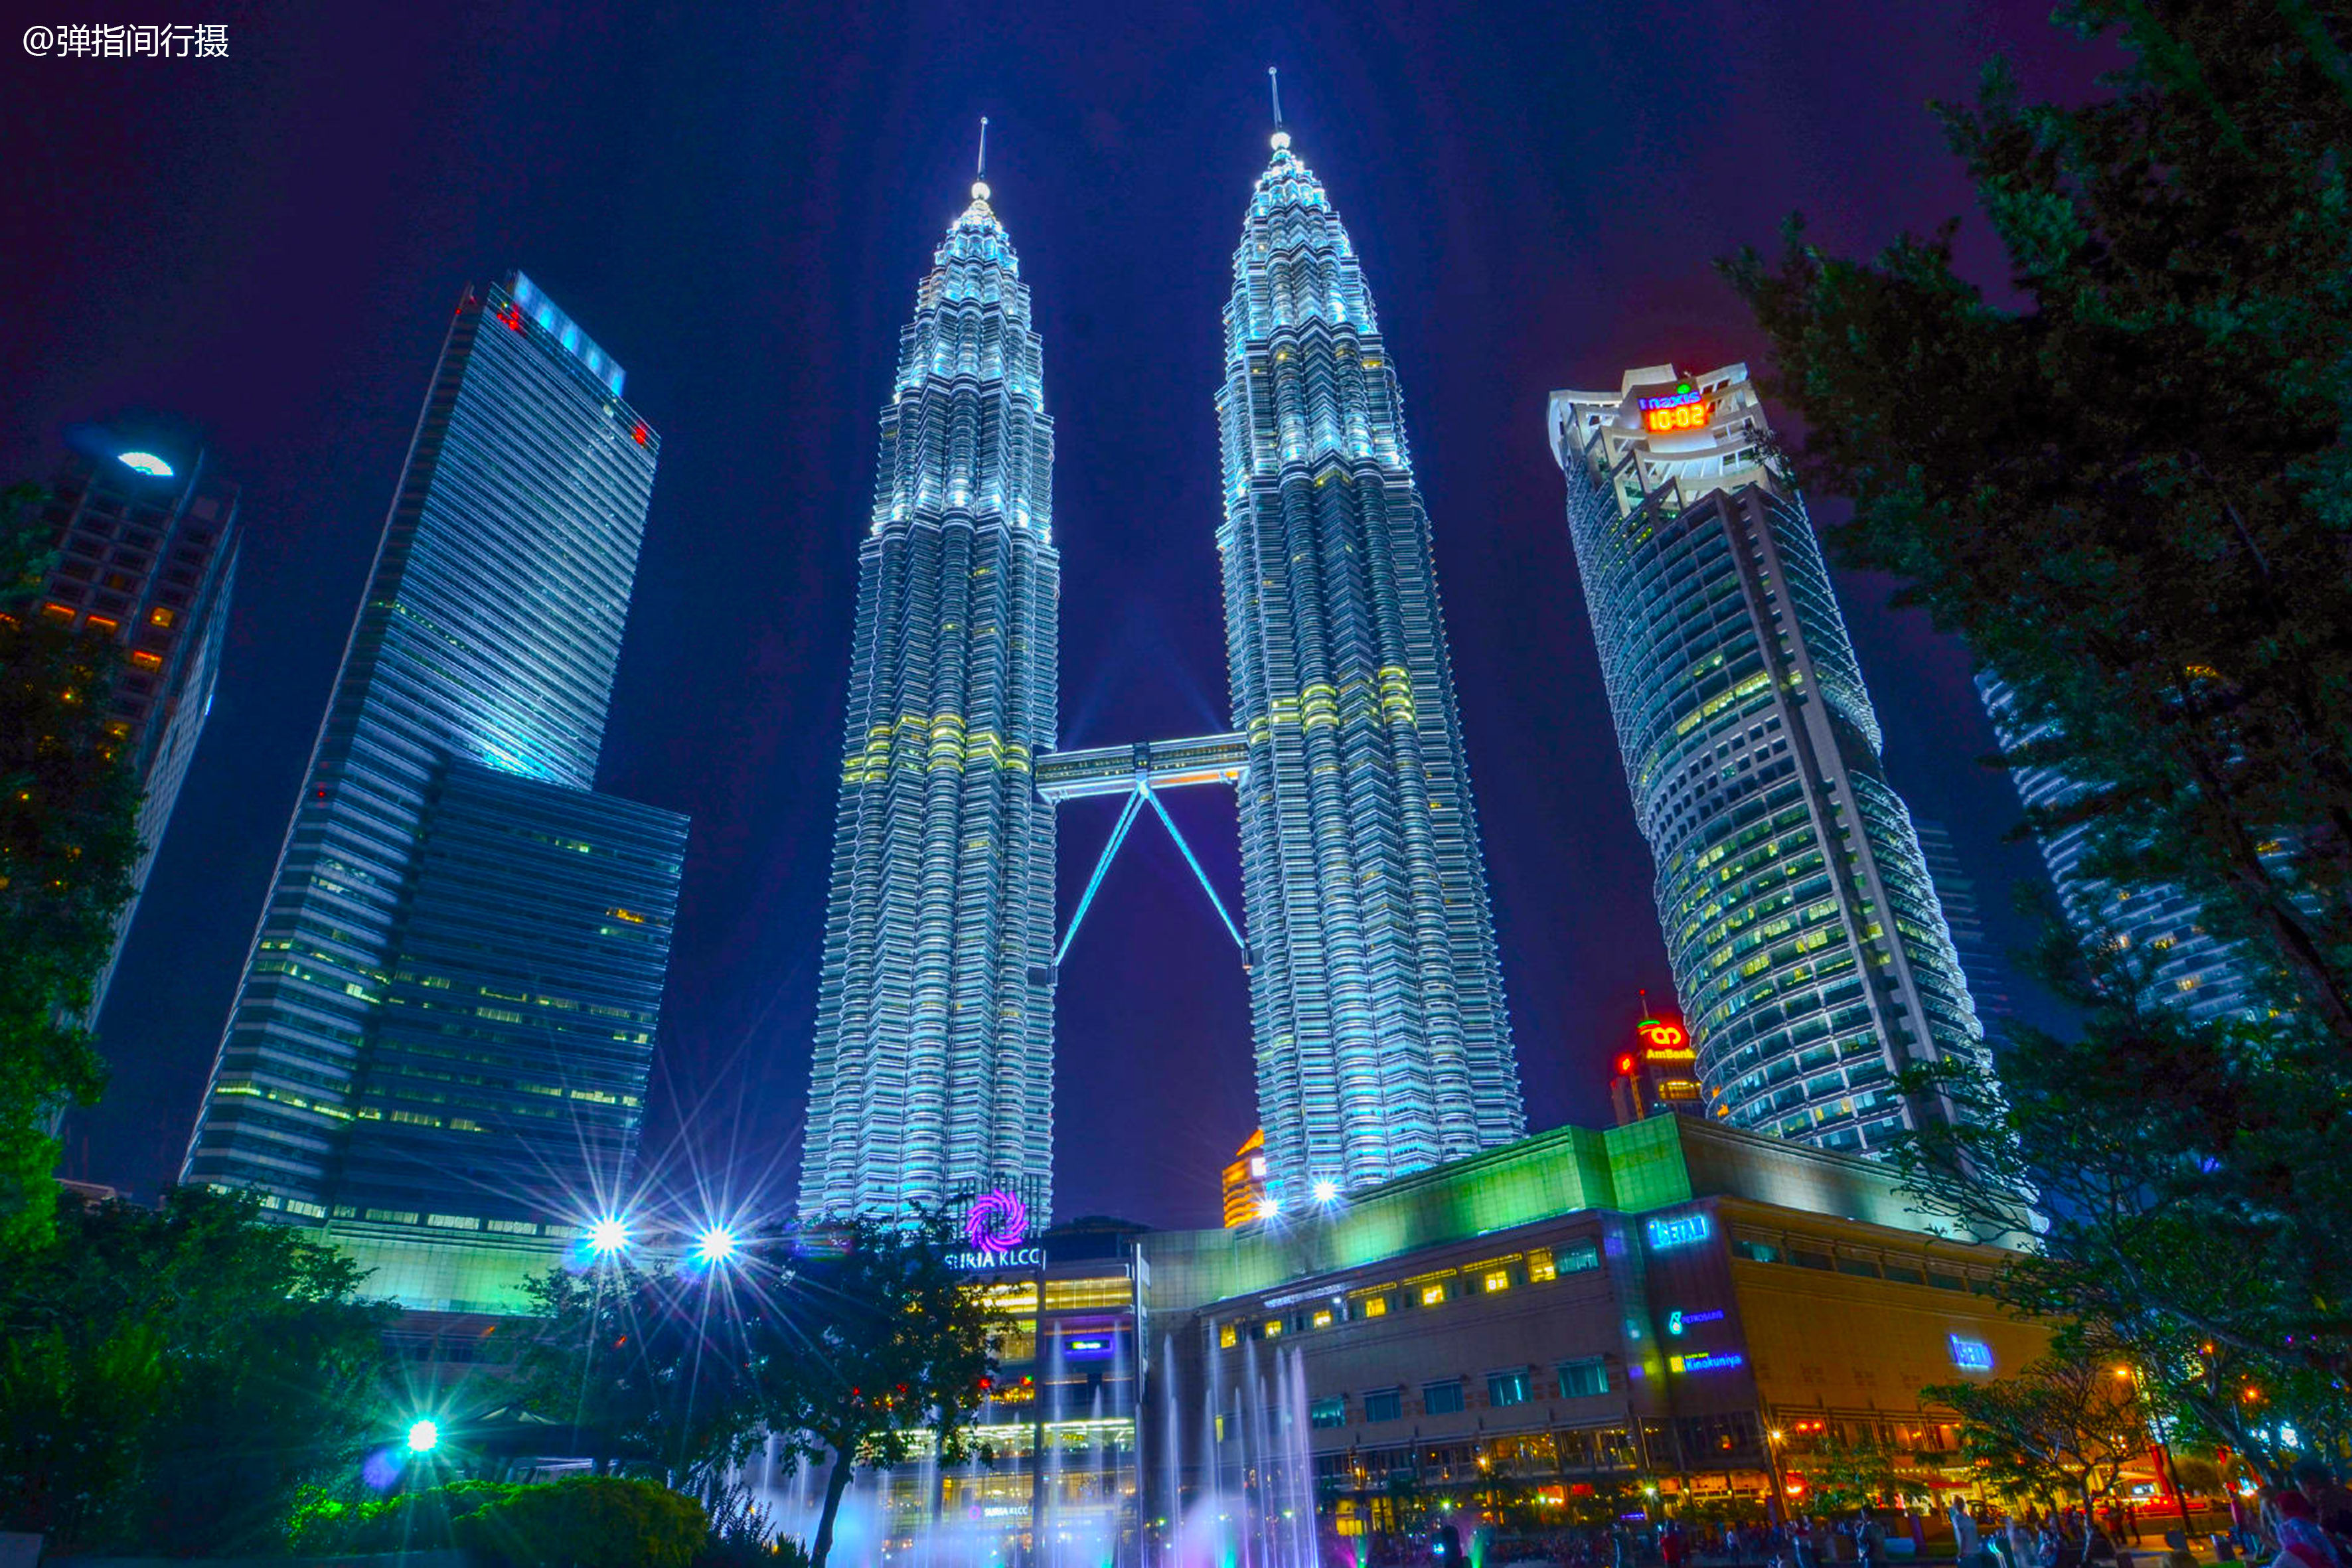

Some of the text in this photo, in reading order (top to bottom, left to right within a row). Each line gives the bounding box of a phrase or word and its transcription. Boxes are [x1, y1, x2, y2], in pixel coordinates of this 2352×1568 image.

[1649, 404, 1704, 430] 10:02
[1646, 1048, 1695, 1059] AmBank
[1000, 1248, 1040, 1266] KLCC
[1686, 1354, 1742, 1372] Kinokuniya
